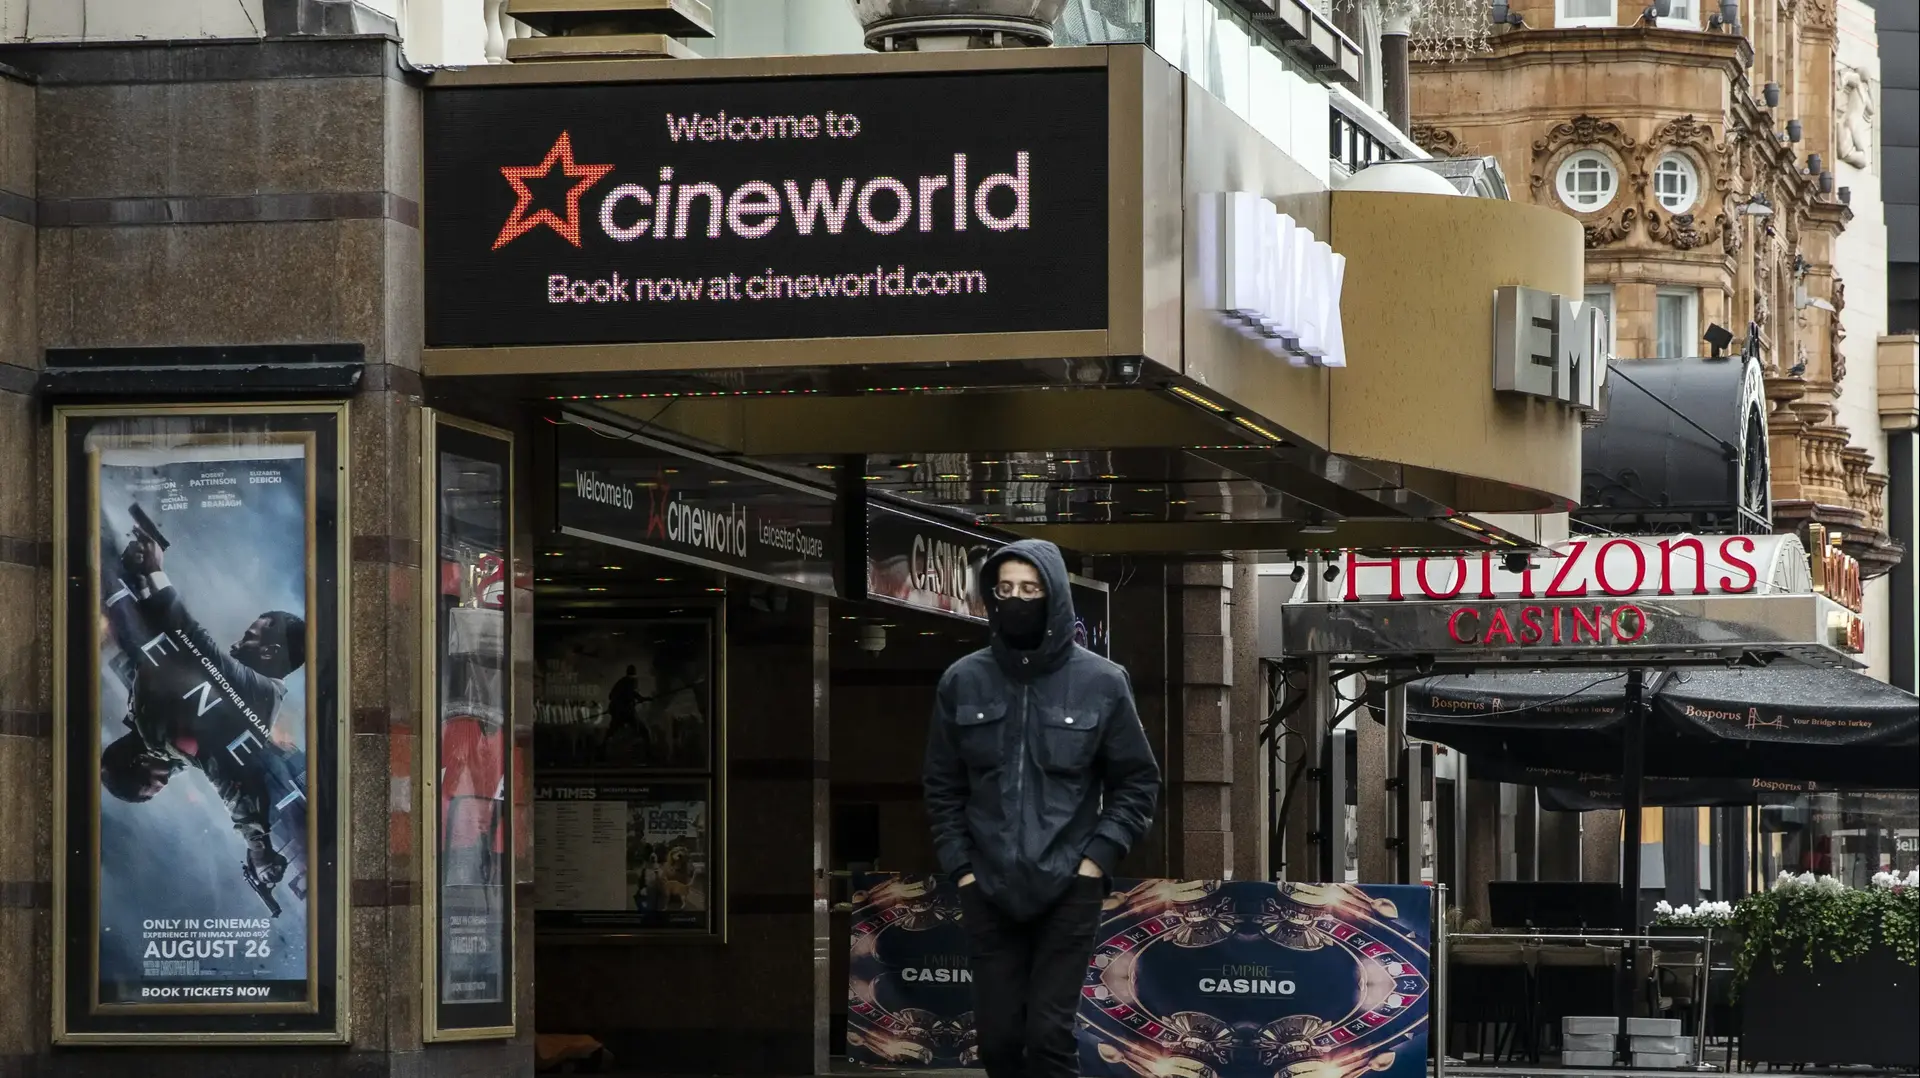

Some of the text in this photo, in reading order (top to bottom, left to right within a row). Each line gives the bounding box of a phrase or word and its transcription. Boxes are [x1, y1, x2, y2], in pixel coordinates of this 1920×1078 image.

[667, 110, 861, 141] Welcome to
[599, 151, 1031, 241] cineworld
[548, 265, 987, 303] Book now at cineworld.com
[189, 478, 237, 487] PATTINSON
[249, 476, 282, 484] DEBICKI
[576, 468, 633, 510] Welcome to
[162, 502, 188, 511] CAINE
[201, 500, 242, 508] BRANAGH
[667, 492, 747, 558] cineworld
[758, 518, 823, 560] Leicester Square
[910, 533, 968, 601] CASINO
[1448, 605, 1648, 645] CASINO
[174, 628, 271, 739] A FILM BY CHRISTOPHER NOLAN
[1432, 696, 1485, 712] Bosporus
[1684, 704, 1742, 721] Bosporus
[1792, 717, 1810, 726] Your
[1812, 718, 1837, 728] Bridge
[1848, 720, 1873, 728] Turkey
[556, 787, 597, 800] TIMES
[1752, 778, 1802, 791] Bosporus
[143, 918, 270, 930] ONLY IN CINEMAS
[144, 940, 270, 958] AUGUST 26
[901, 967, 973, 983] CASIN
[142, 986, 270, 997] BOOK TICKETS NOW
[1198, 977, 1296, 995] CASINO
